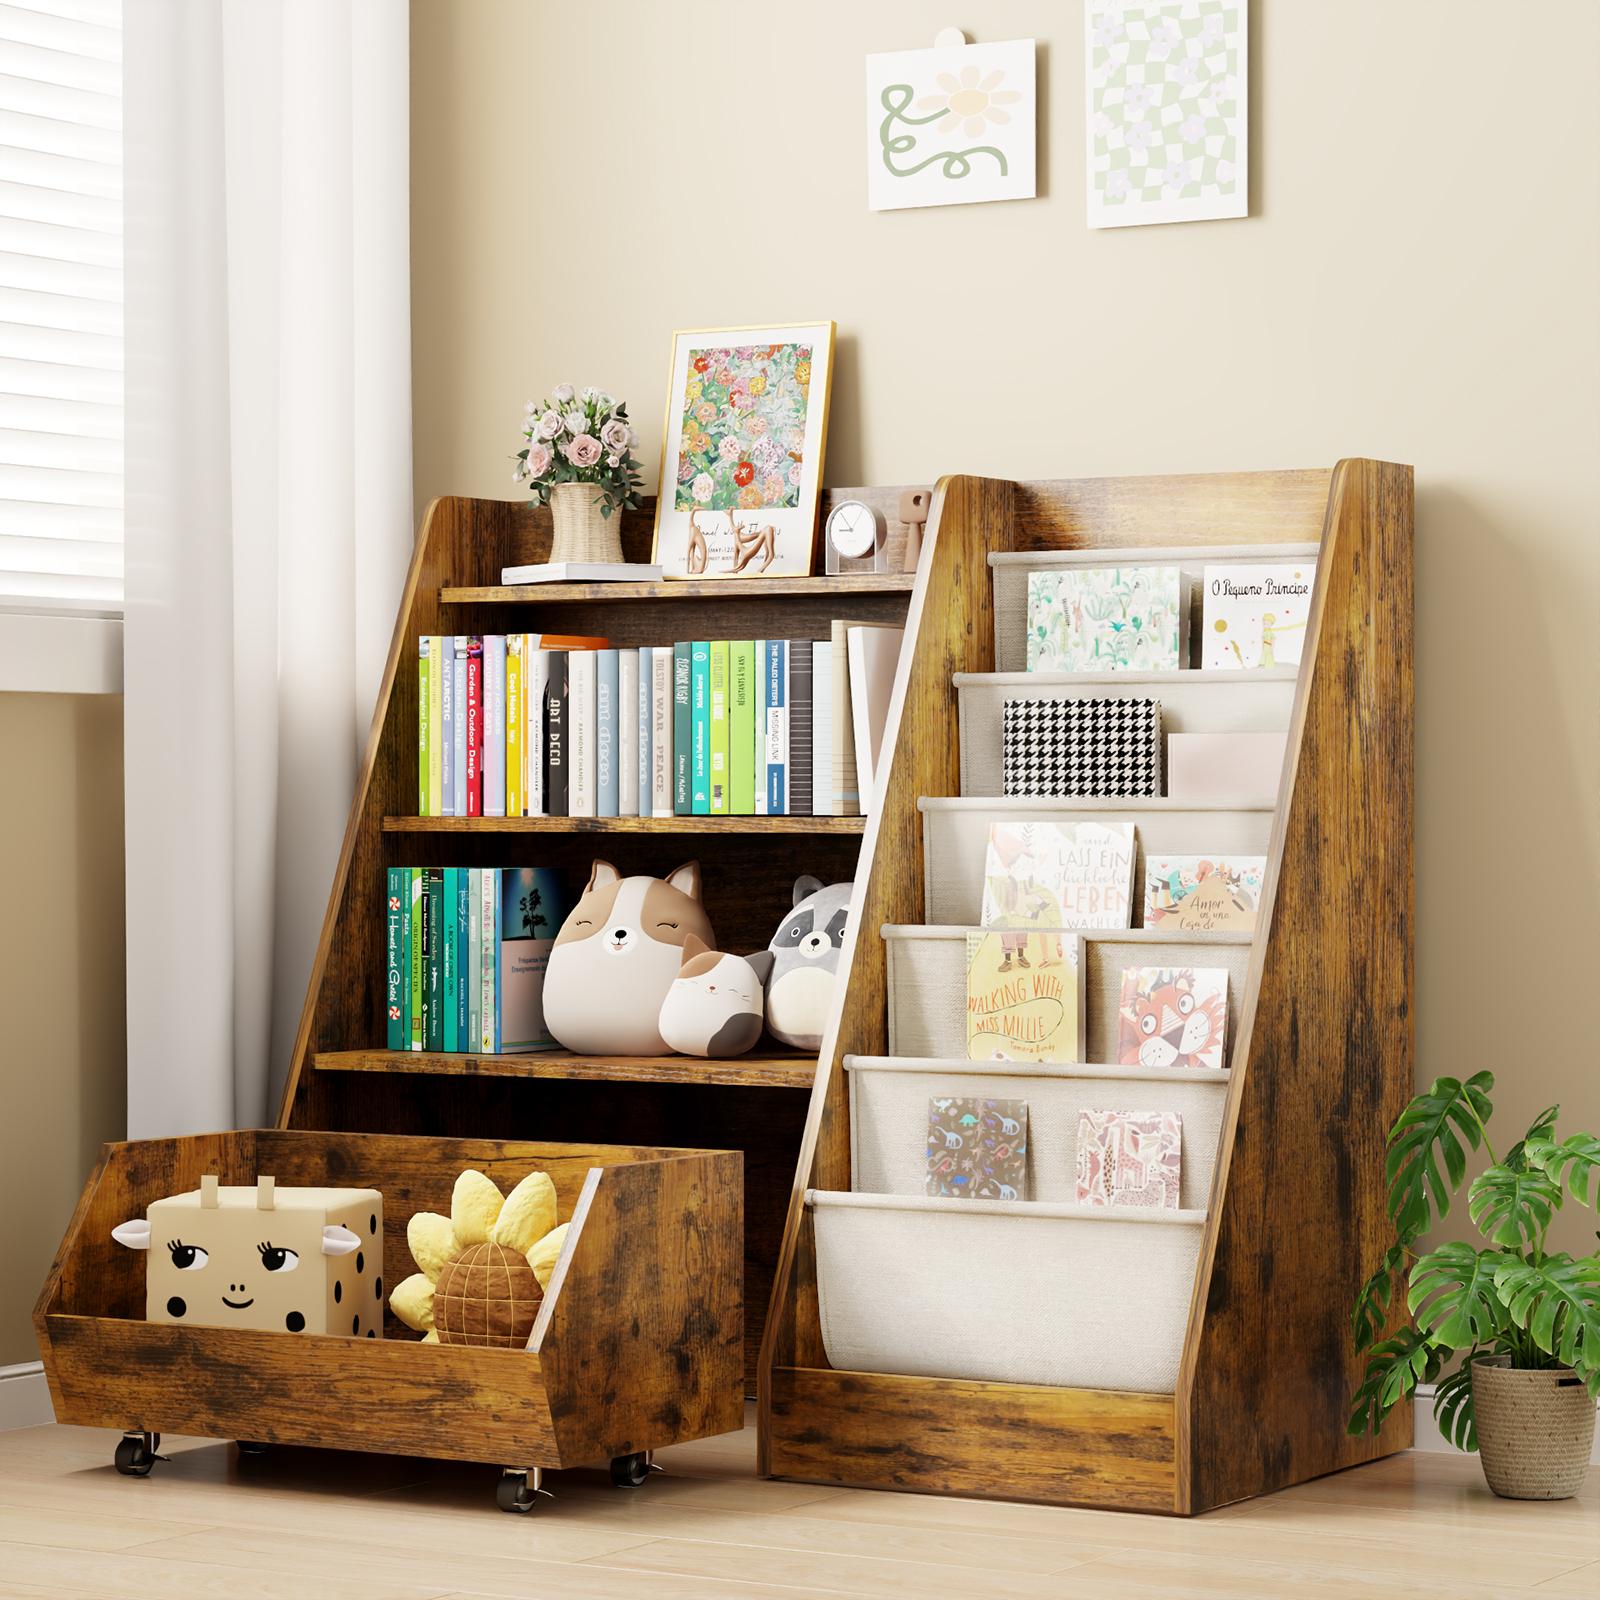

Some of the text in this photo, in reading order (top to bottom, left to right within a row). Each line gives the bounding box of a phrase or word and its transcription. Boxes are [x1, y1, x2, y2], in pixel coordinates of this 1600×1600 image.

[1212, 579, 1221, 596] O
[1223, 578, 1262, 600] Pequeno
[443, 658, 451, 721] ANTARCTIC
[469, 664, 477, 696] Garden
[509, 673, 517, 693] Cool
[676, 658, 689, 704] ELEANOR RIGBY
[420, 677, 428, 751] Ecological Design
[655, 658, 665, 793] TOLSTOY WAR PEACE
[771, 710, 780, 742] MISSING
[550, 698, 561, 766] ART DECO
[467, 750, 476, 779] Design
[599, 726, 611, 786] deco
[771, 743, 779, 760] LINK
[1059, 847, 1130, 870] LASS EIN
[1190, 895, 1225, 912] Amor
[389, 915, 400, 1002] Hansel and Gretel
[968, 973, 1065, 1013] WALKING WITH
[976, 1014, 1046, 1041] MISS MILLIE
